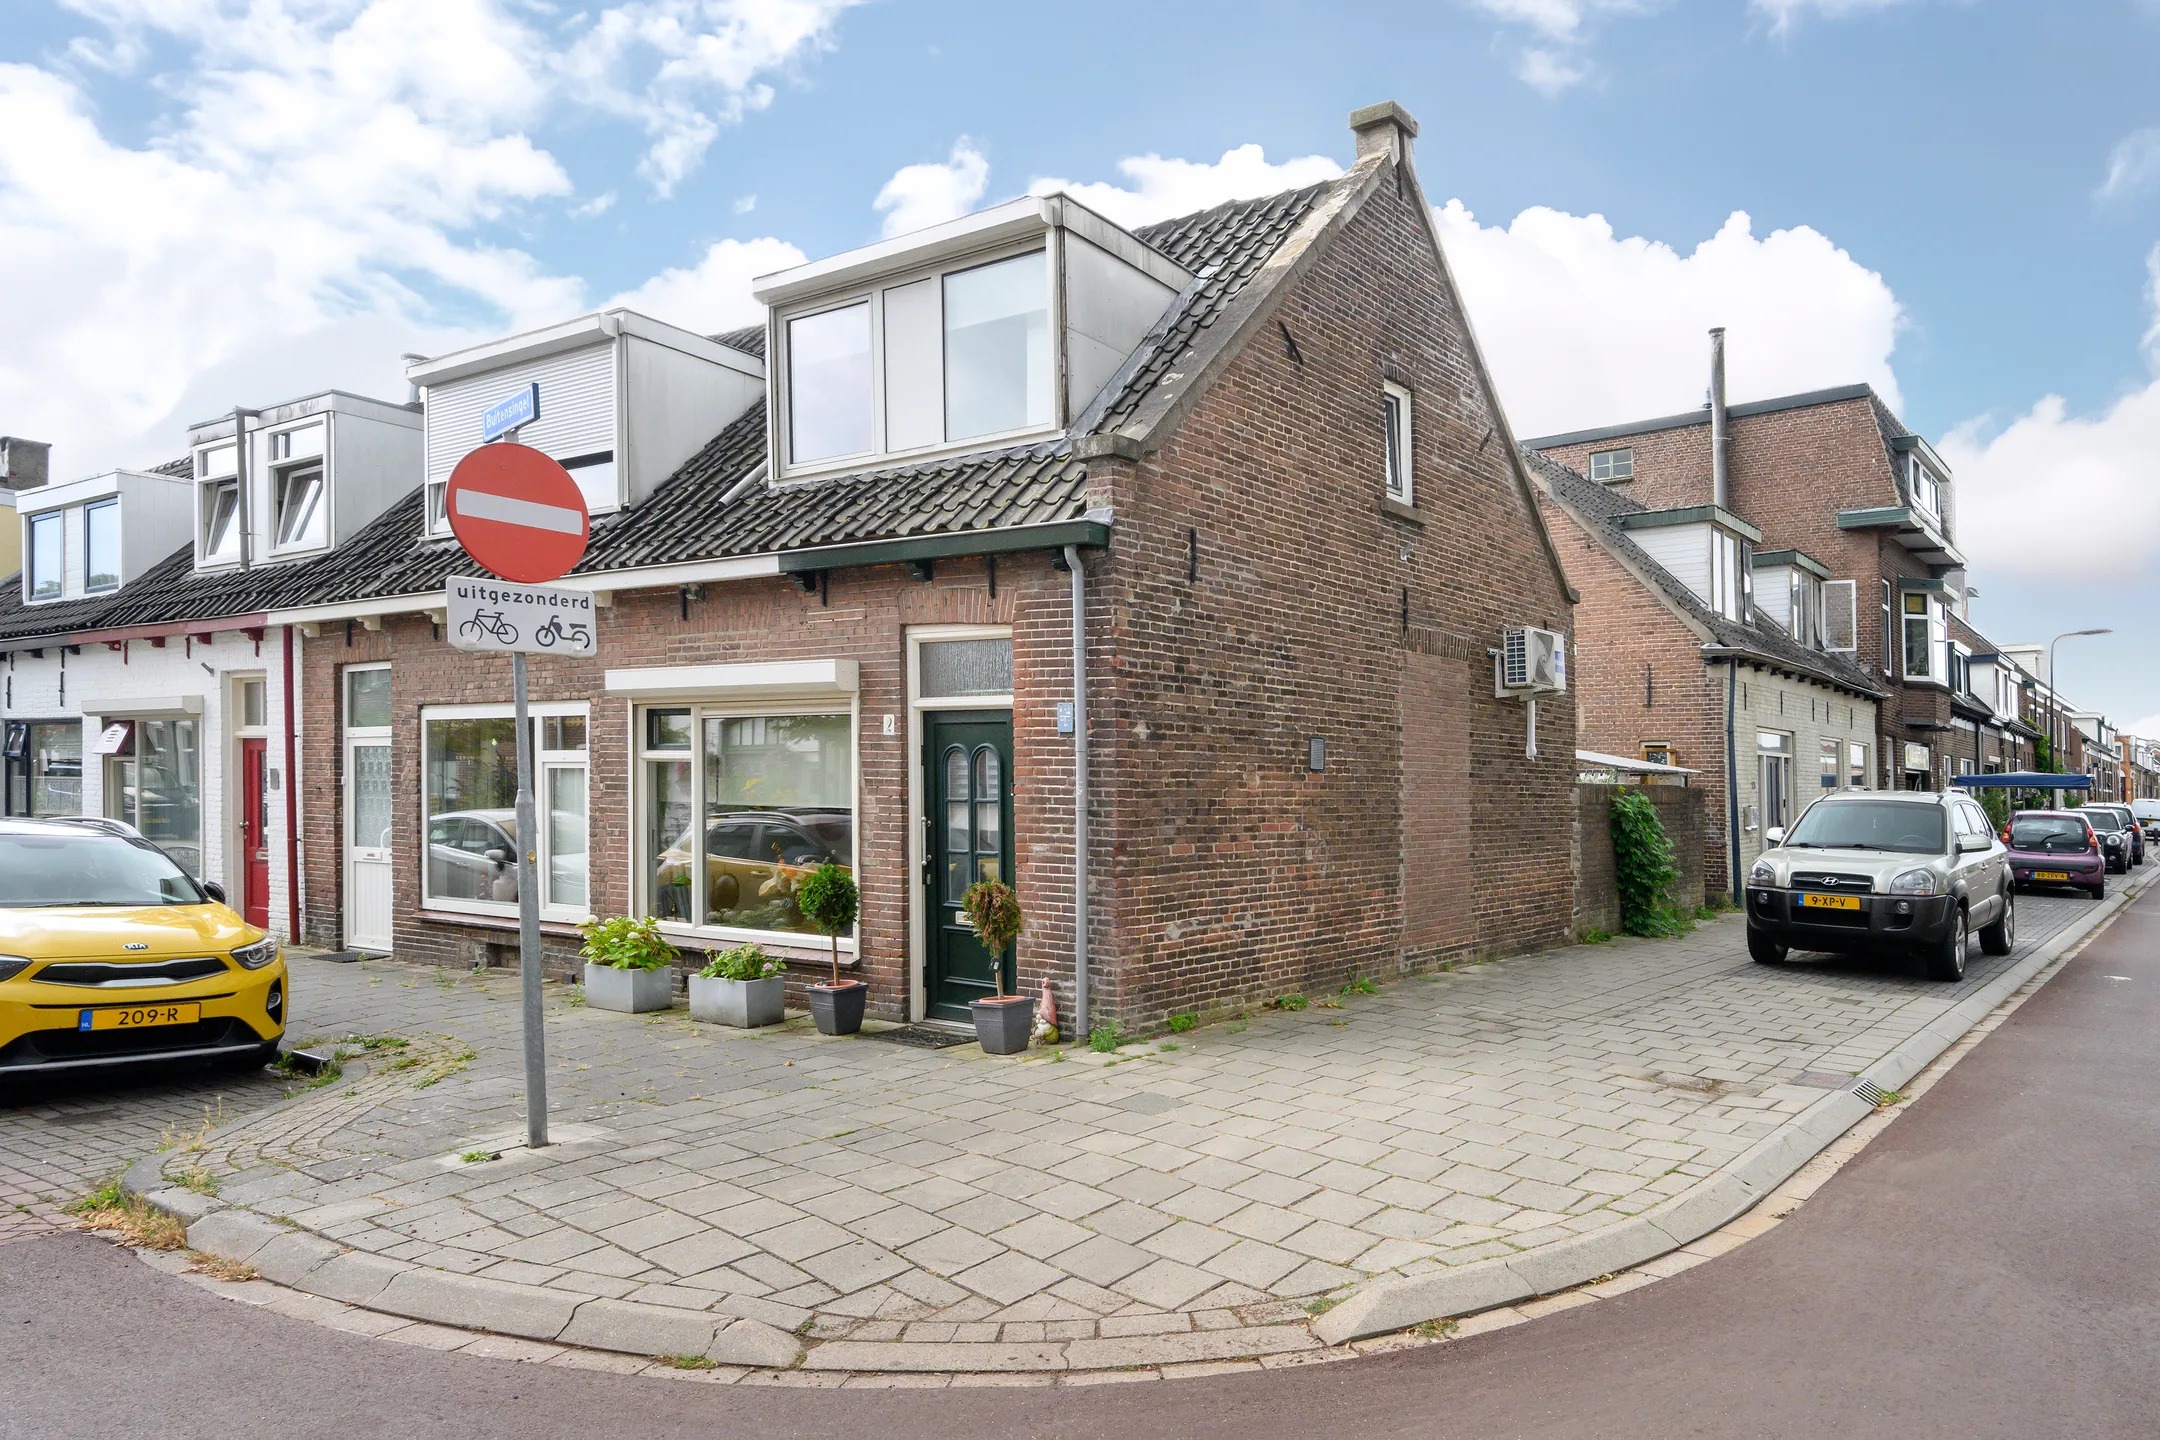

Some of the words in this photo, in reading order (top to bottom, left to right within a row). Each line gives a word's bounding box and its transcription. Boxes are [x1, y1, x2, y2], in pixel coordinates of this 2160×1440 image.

[486, 394, 530, 429] Buitensingel
[458, 586, 590, 610] uitgezonderd
[1812, 896, 1846, 907] 9-XP-V
[118, 1008, 178, 1026] 209-R
